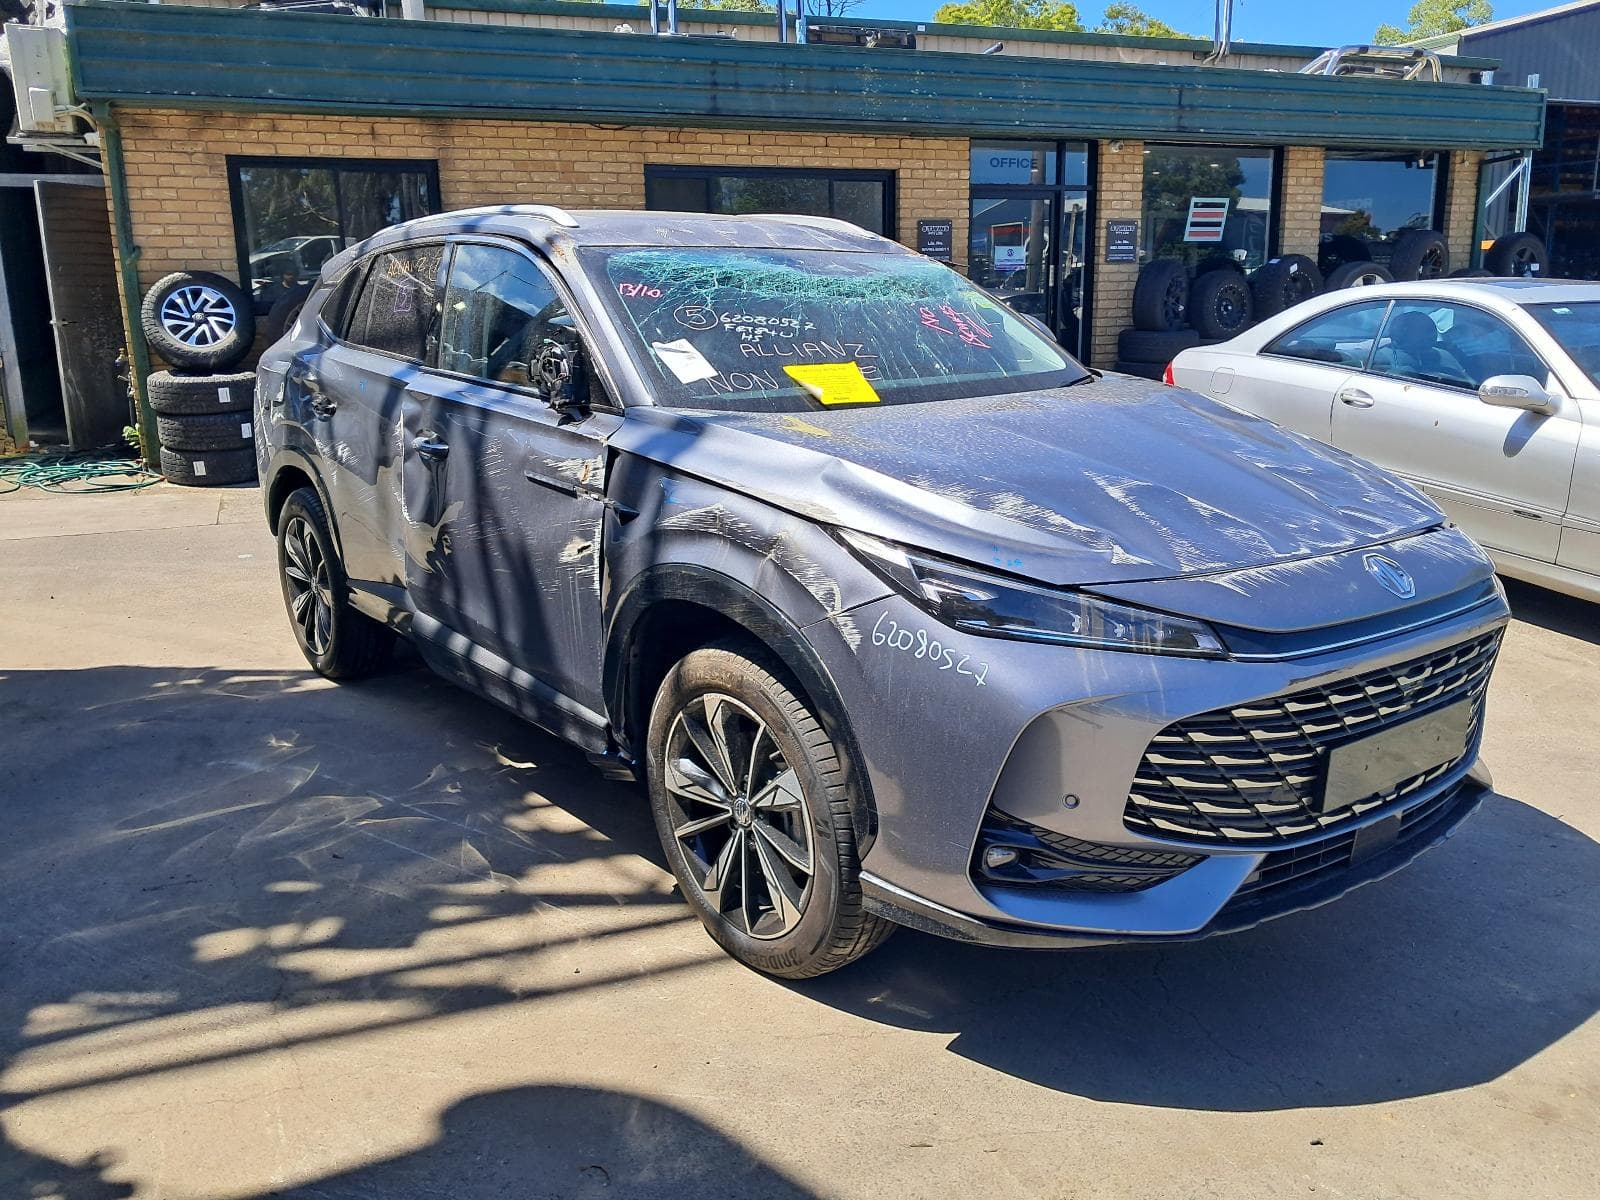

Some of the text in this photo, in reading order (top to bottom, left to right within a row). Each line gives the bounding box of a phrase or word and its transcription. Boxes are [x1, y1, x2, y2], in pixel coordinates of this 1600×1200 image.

[990, 157, 1038, 169] OFFICE
[740, 338, 879, 359] ALLIANZ
[704, 370, 779, 396] NON
[872, 611, 989, 687] 62080527
